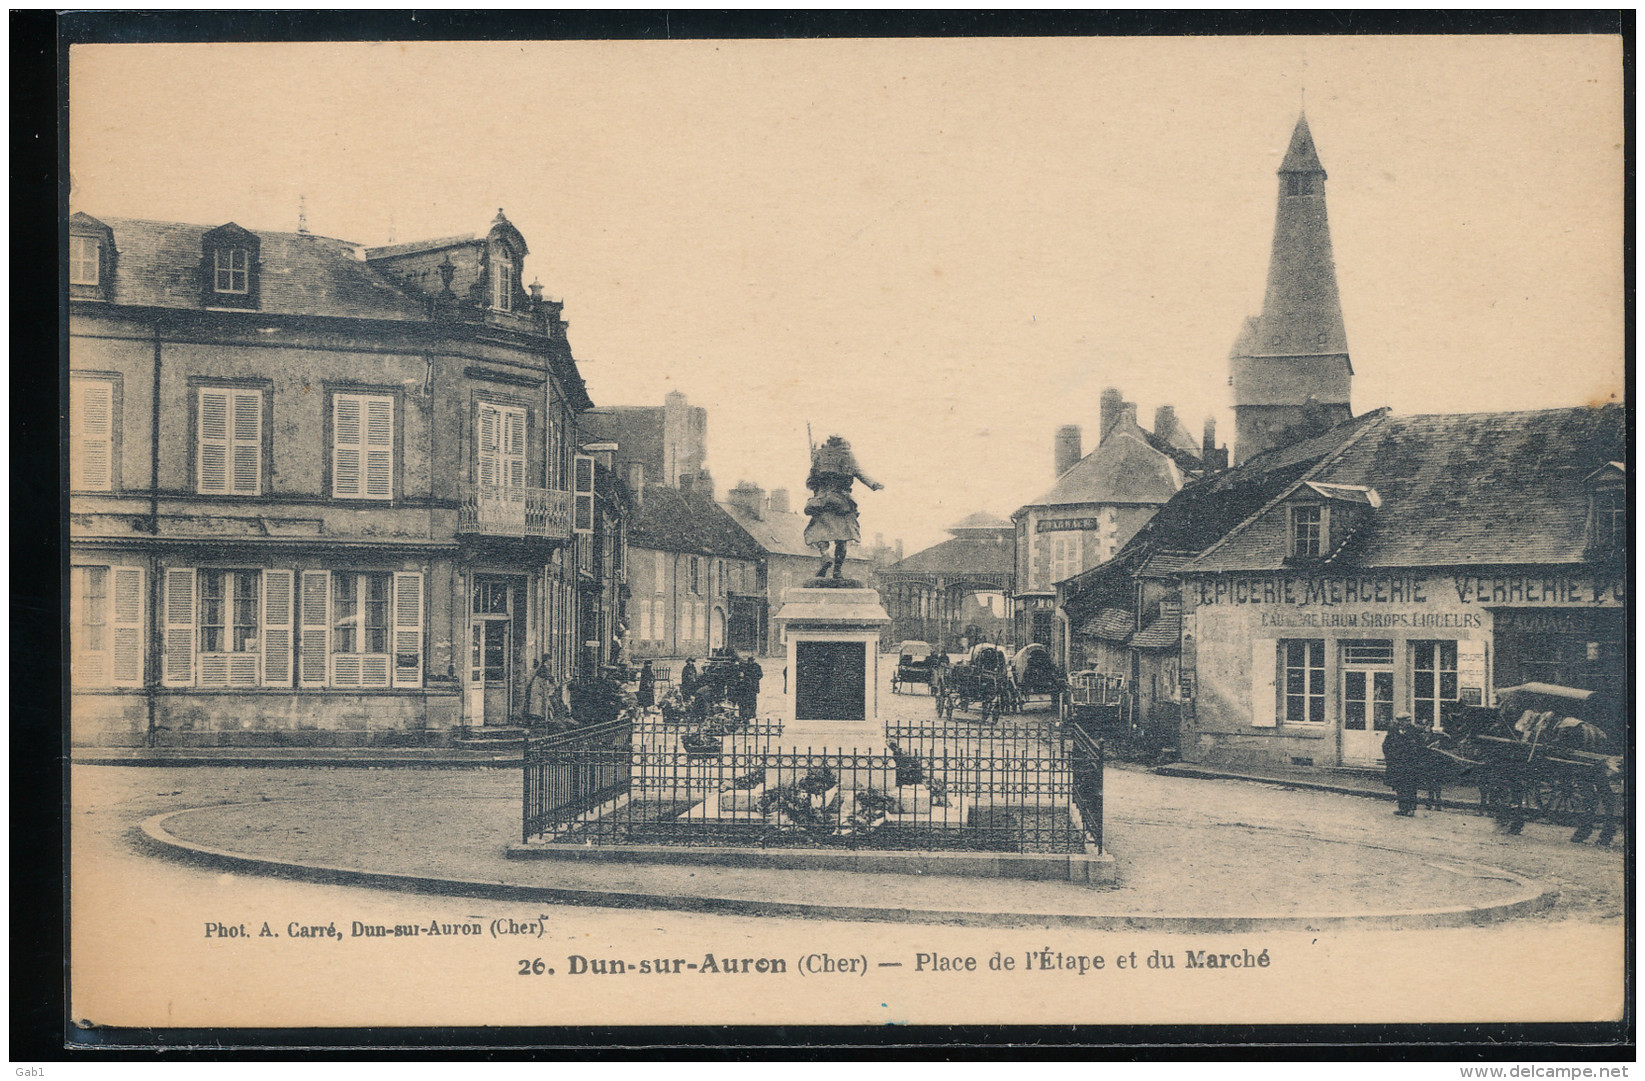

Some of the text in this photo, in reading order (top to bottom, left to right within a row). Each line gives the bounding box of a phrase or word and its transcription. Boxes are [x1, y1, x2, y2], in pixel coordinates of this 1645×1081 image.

[1196, 578, 1296, 606] EPICERIE
[1297, 576, 1426, 606] MERCERIE
[1455, 577, 1582, 603] VERRERIE
[1322, 612, 1359, 627] RHUM
[1361, 612, 1407, 628] SIROPS
[1413, 612, 1482, 629] LIQUEURS
